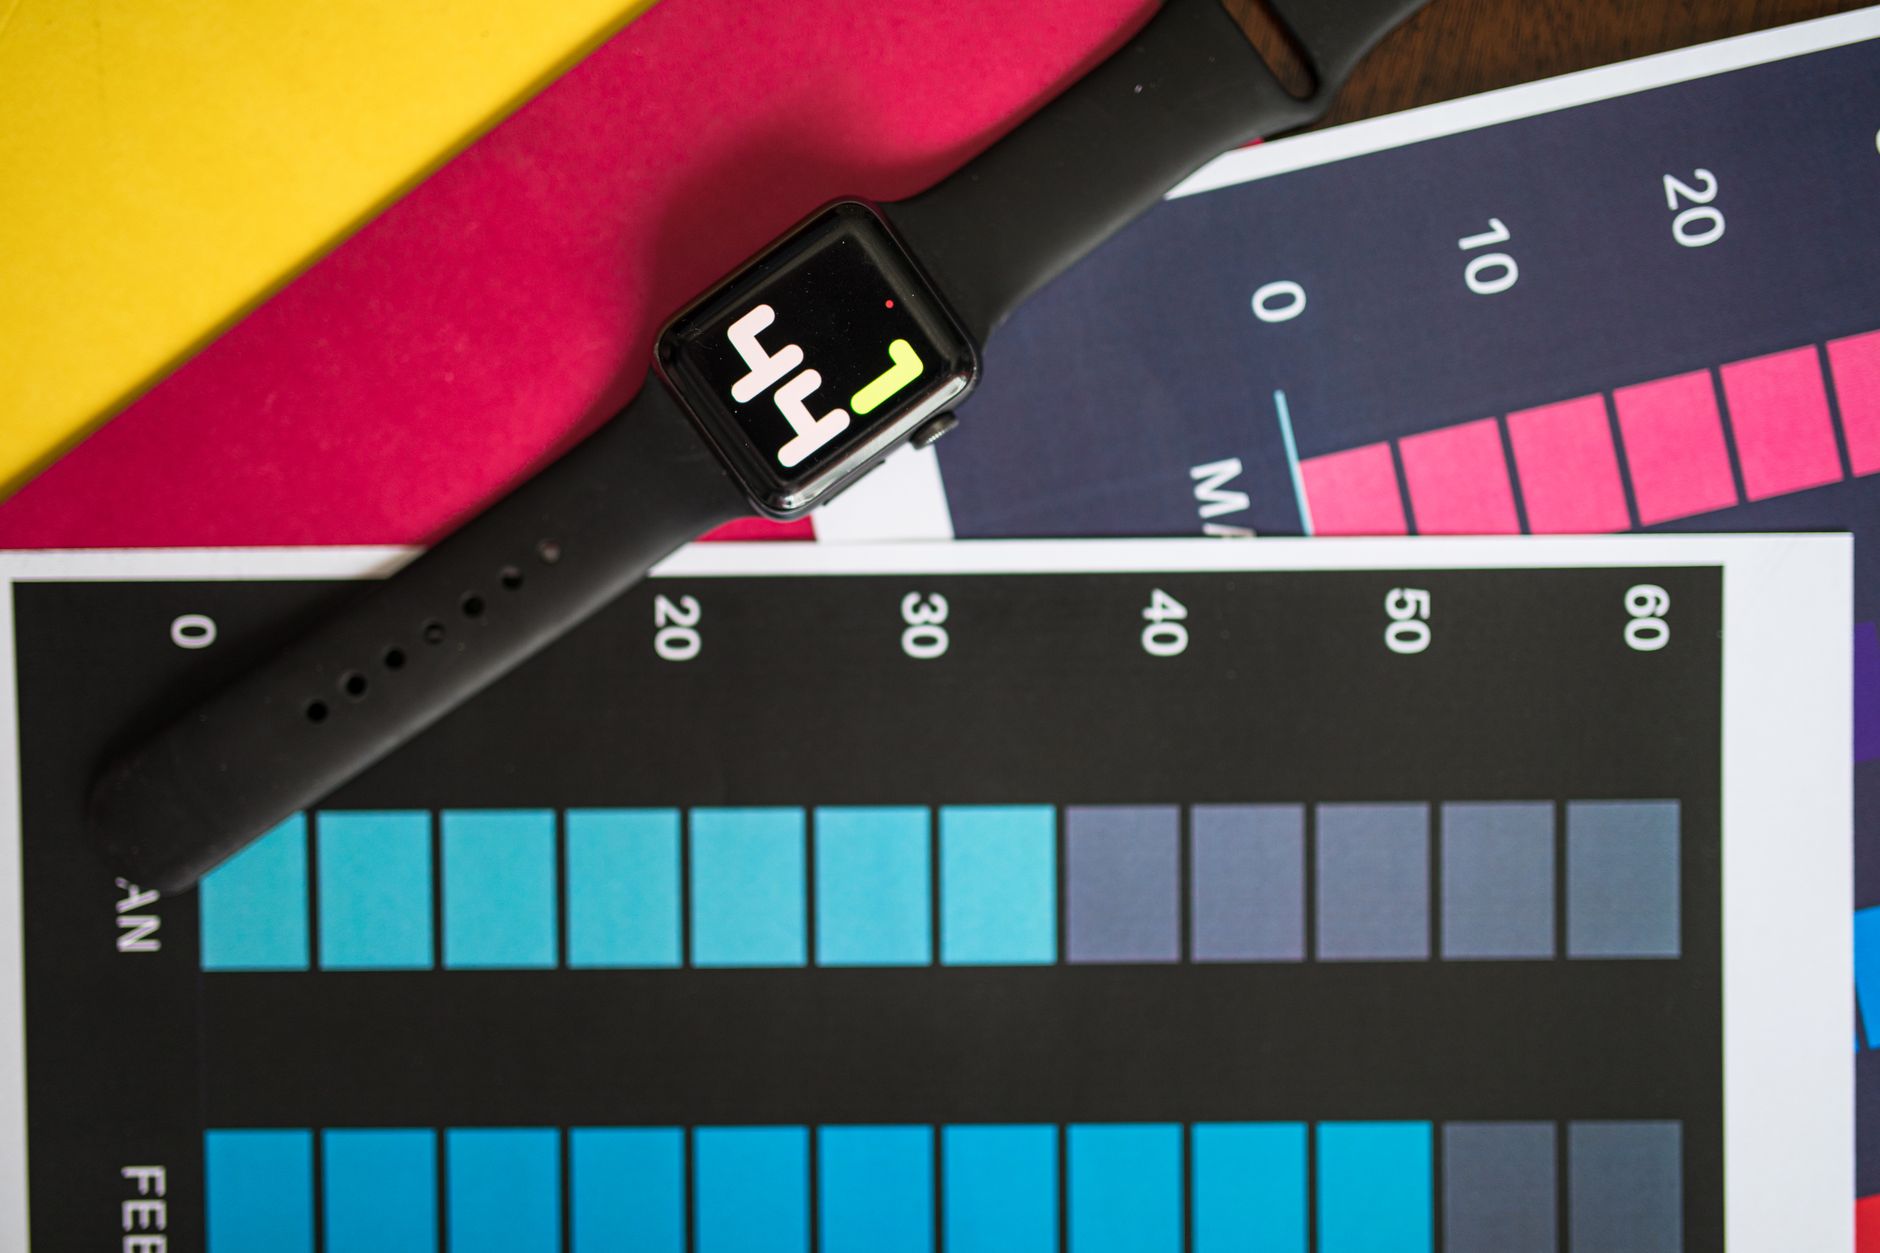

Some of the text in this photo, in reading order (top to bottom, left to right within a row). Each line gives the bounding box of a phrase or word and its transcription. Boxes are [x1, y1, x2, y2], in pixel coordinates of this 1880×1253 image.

[1664, 168, 1726, 248] 20
[1458, 218, 1519, 295] 10
[1251, 280, 1307, 323] 0
[727, 304, 851, 468] 44
[171, 614, 217, 649] 0
[654, 595, 702, 661] 20
[901, 592, 949, 659] 30
[1141, 588, 1189, 657] 40
[1384, 587, 1431, 654] 50
[1624, 584, 1670, 651] 60
[116, 877, 161, 952] AN
